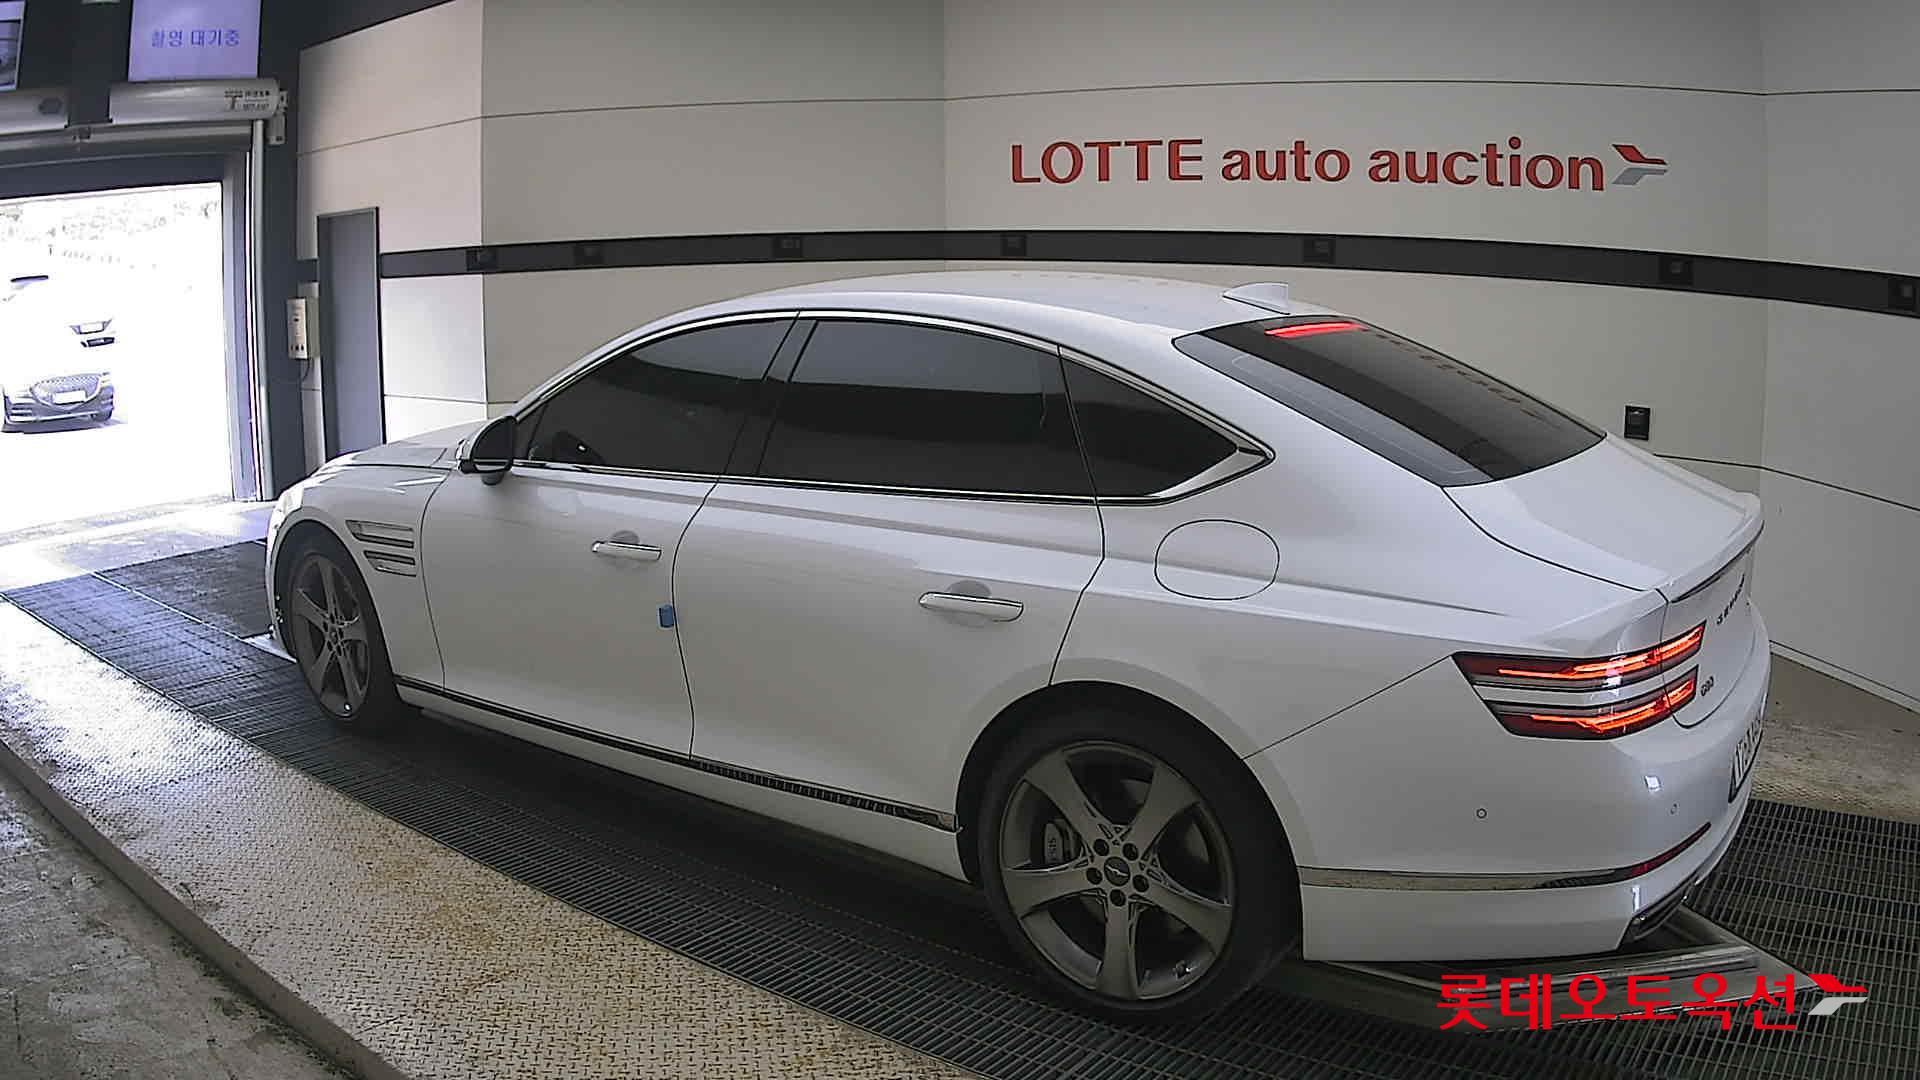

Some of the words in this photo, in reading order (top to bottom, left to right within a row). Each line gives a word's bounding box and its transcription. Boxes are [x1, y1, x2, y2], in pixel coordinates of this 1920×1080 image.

[191, 28, 241, 47] 대기중
[1011, 138, 1204, 184] LOTTE
[1221, 139, 1351, 184] auto
[1368, 136, 1605, 192] auction
